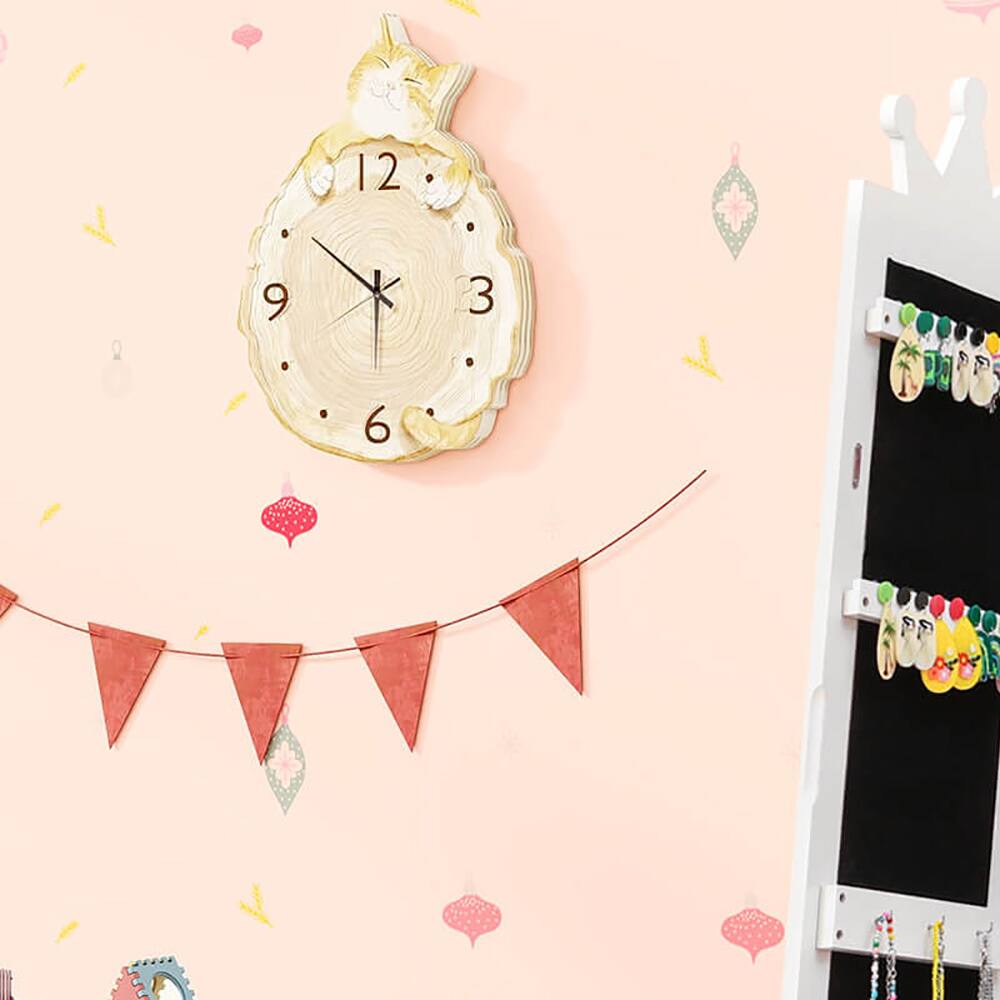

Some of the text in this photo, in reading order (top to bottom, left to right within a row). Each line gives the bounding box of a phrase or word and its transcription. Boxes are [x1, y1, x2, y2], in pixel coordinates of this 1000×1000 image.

[358, 151, 401, 191] 12
[262, 282, 289, 321] 9
[468, 275, 494, 315] 3
[364, 404, 391, 444] 6
